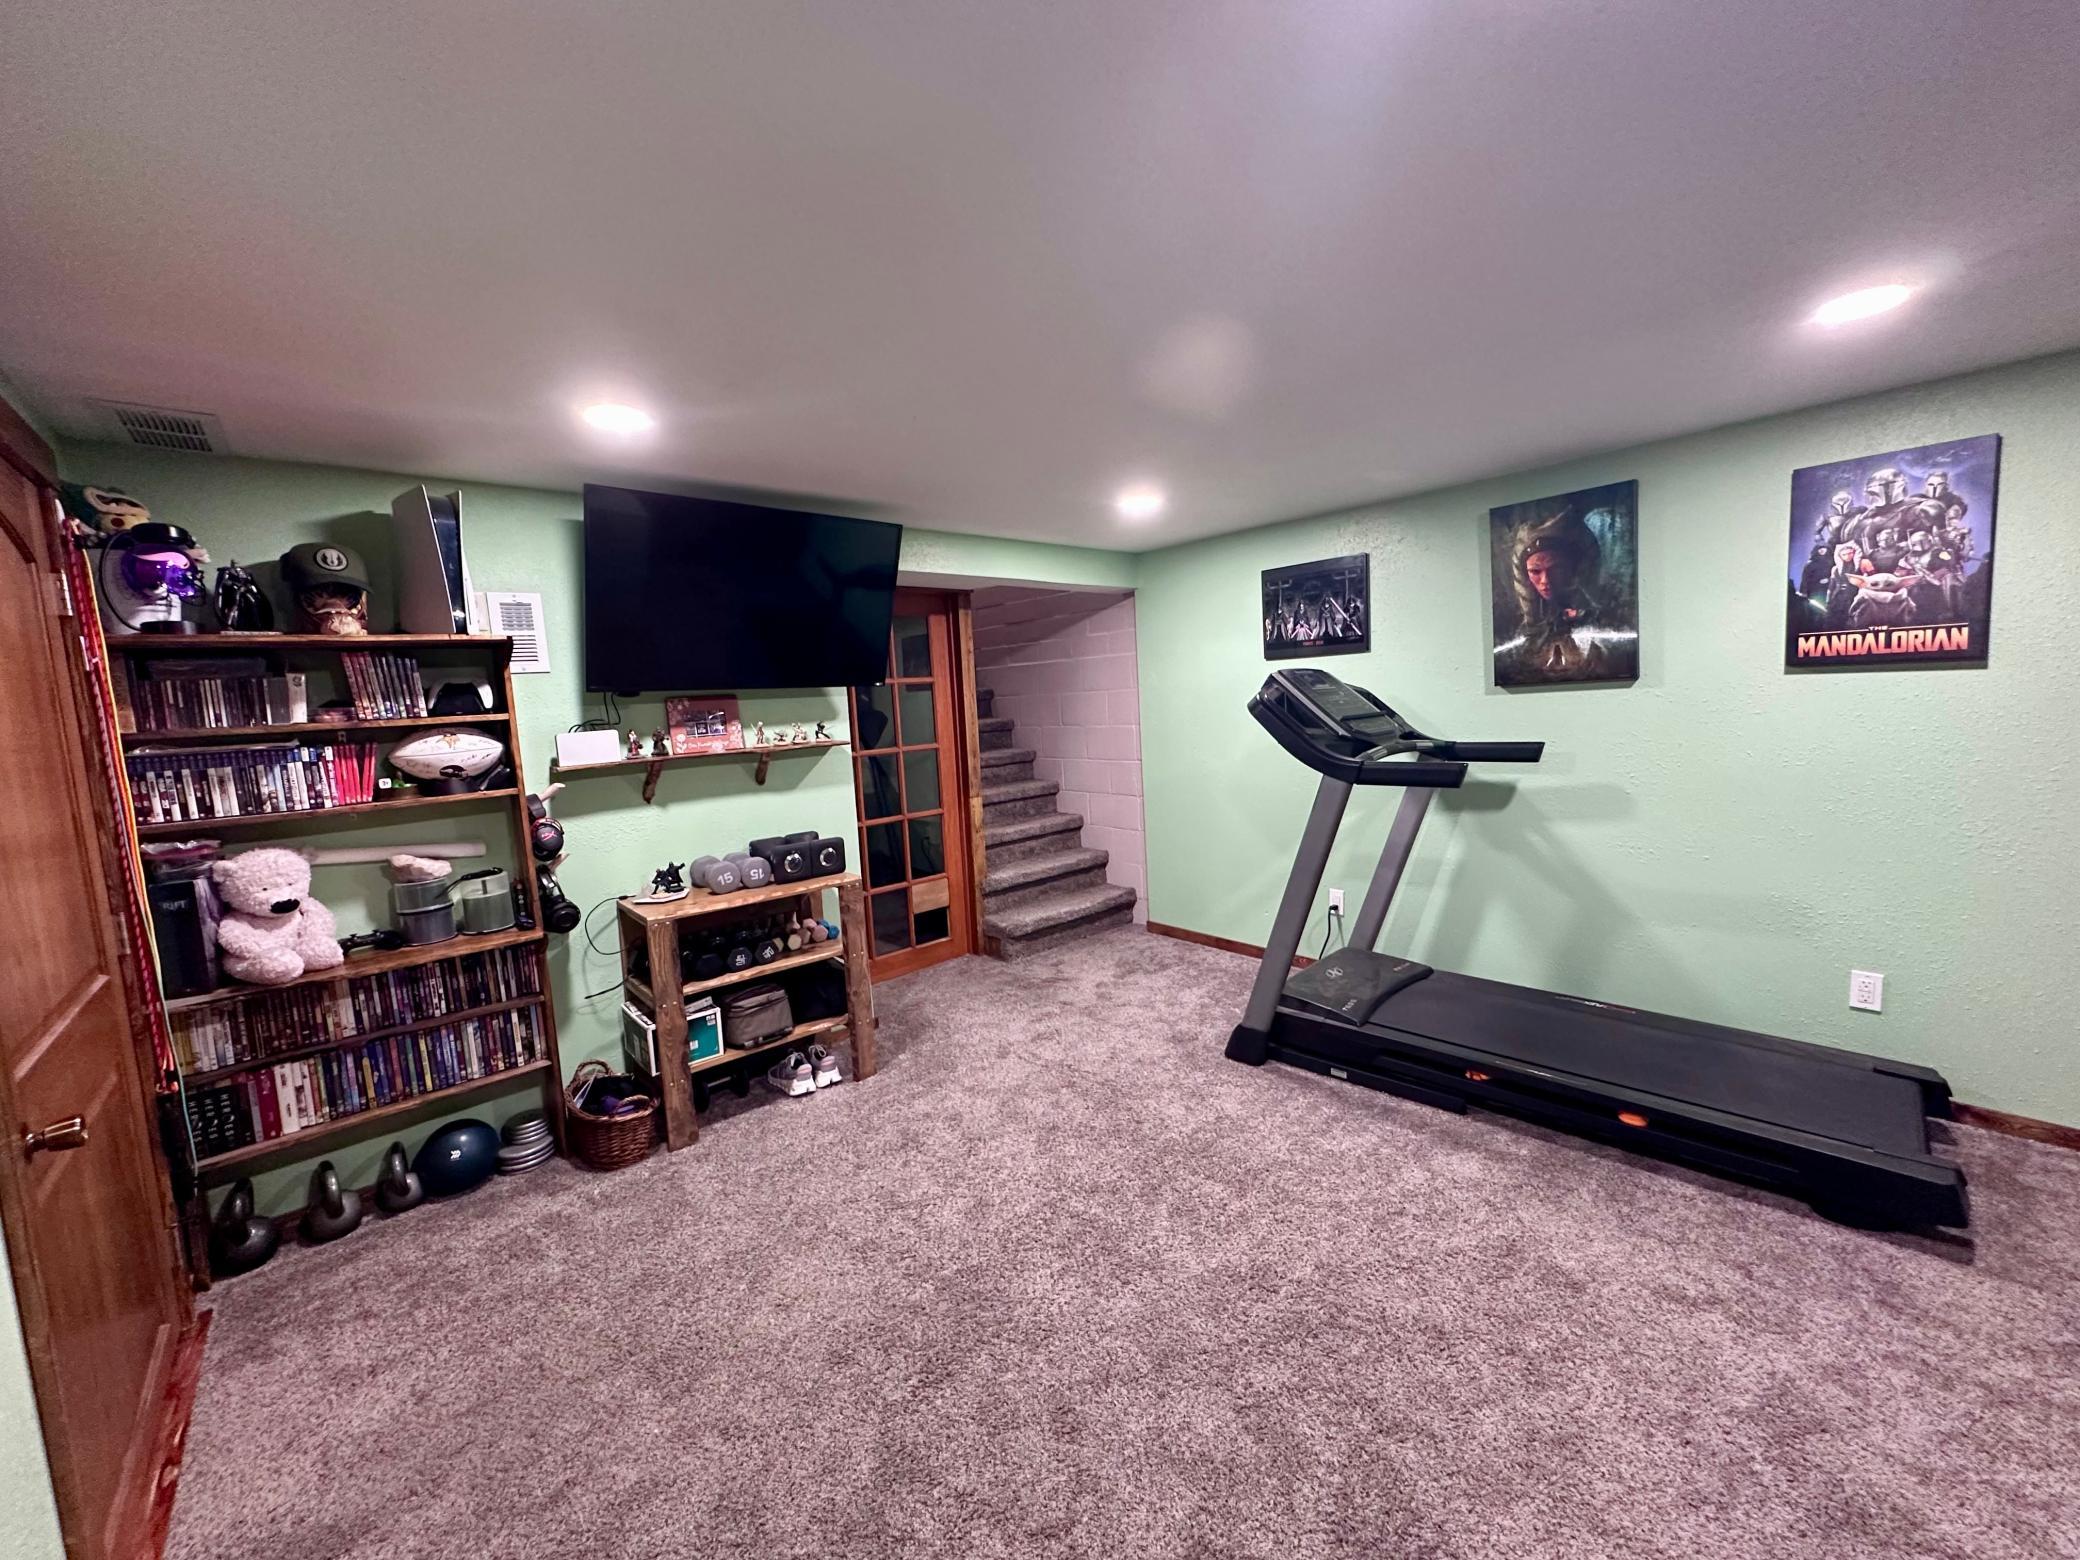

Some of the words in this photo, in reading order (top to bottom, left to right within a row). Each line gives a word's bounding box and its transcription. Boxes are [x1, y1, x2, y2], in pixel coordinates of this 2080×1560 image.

[1797, 626, 1969, 658] MANDALORIAN
[717, 872, 734, 886] 15
[750, 868, 765, 881] 15
